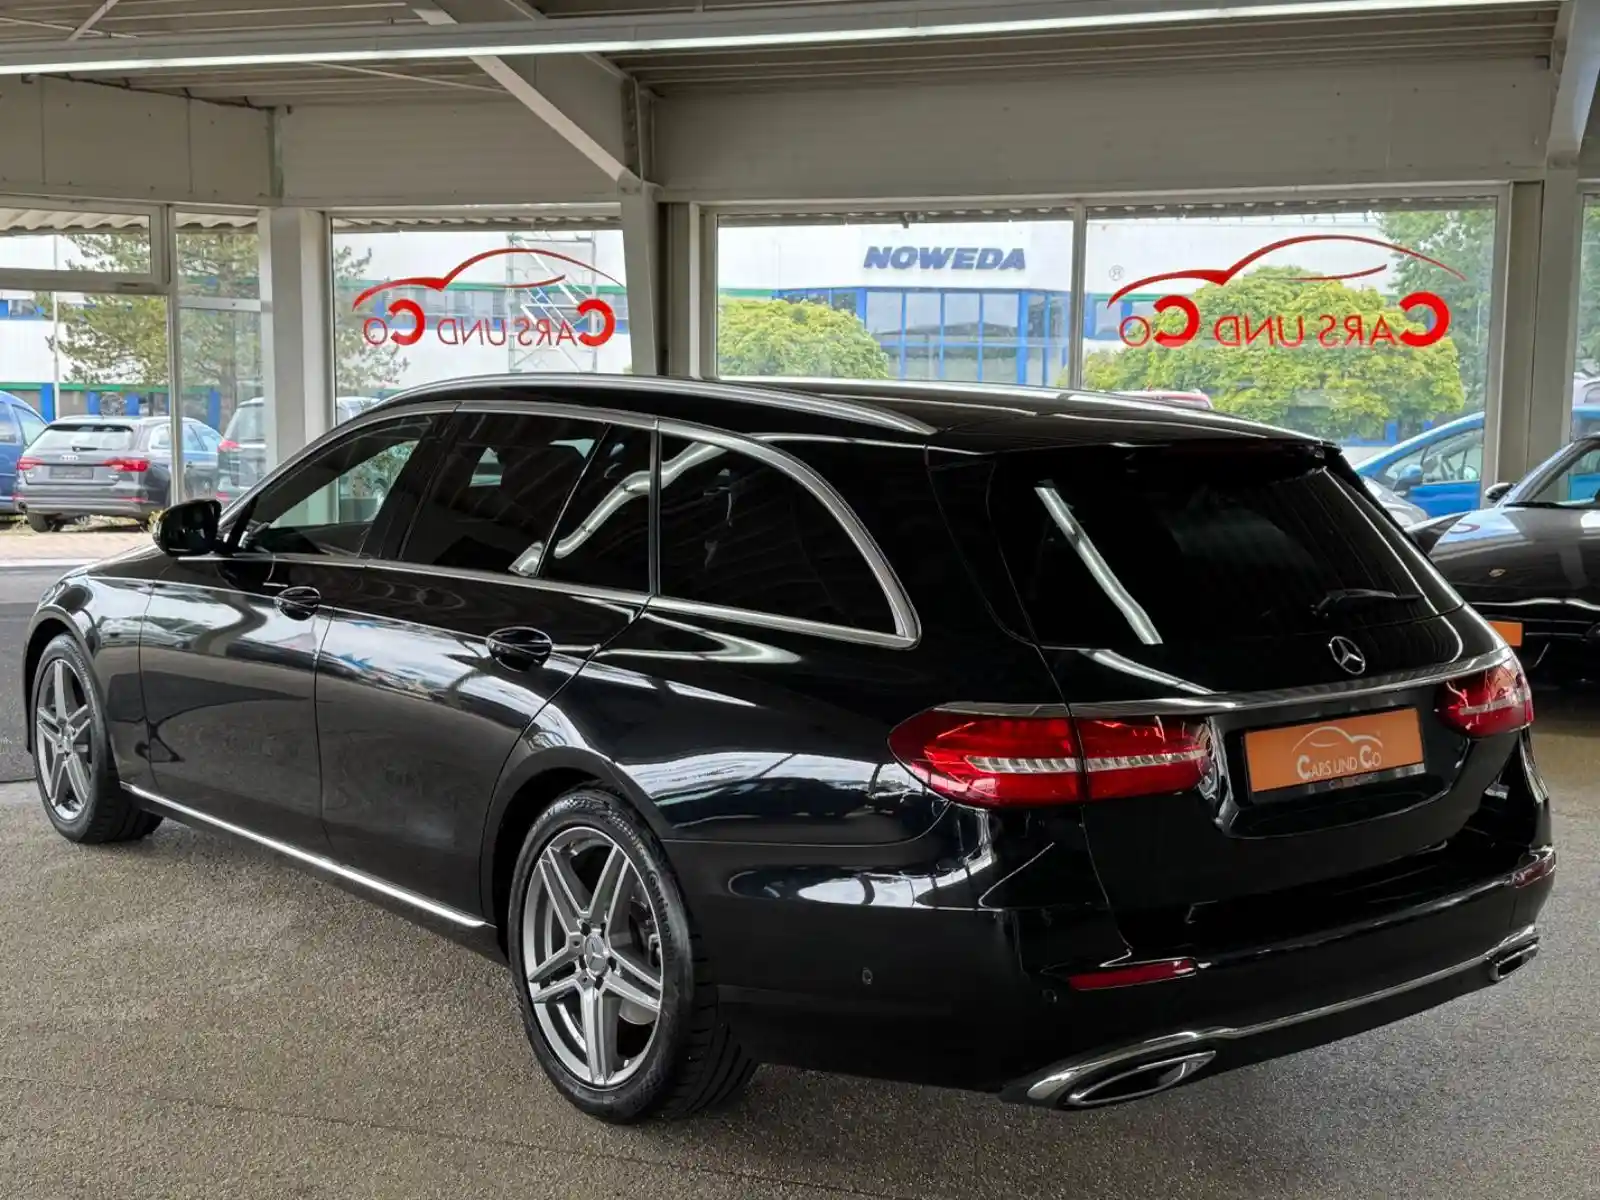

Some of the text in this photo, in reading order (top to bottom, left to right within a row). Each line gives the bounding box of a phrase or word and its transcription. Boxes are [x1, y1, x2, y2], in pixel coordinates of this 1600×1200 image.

[863, 246, 1026, 270] NOWEDA
[1296, 755, 1332, 780] CARS
[1334, 756, 1358, 774] UND
